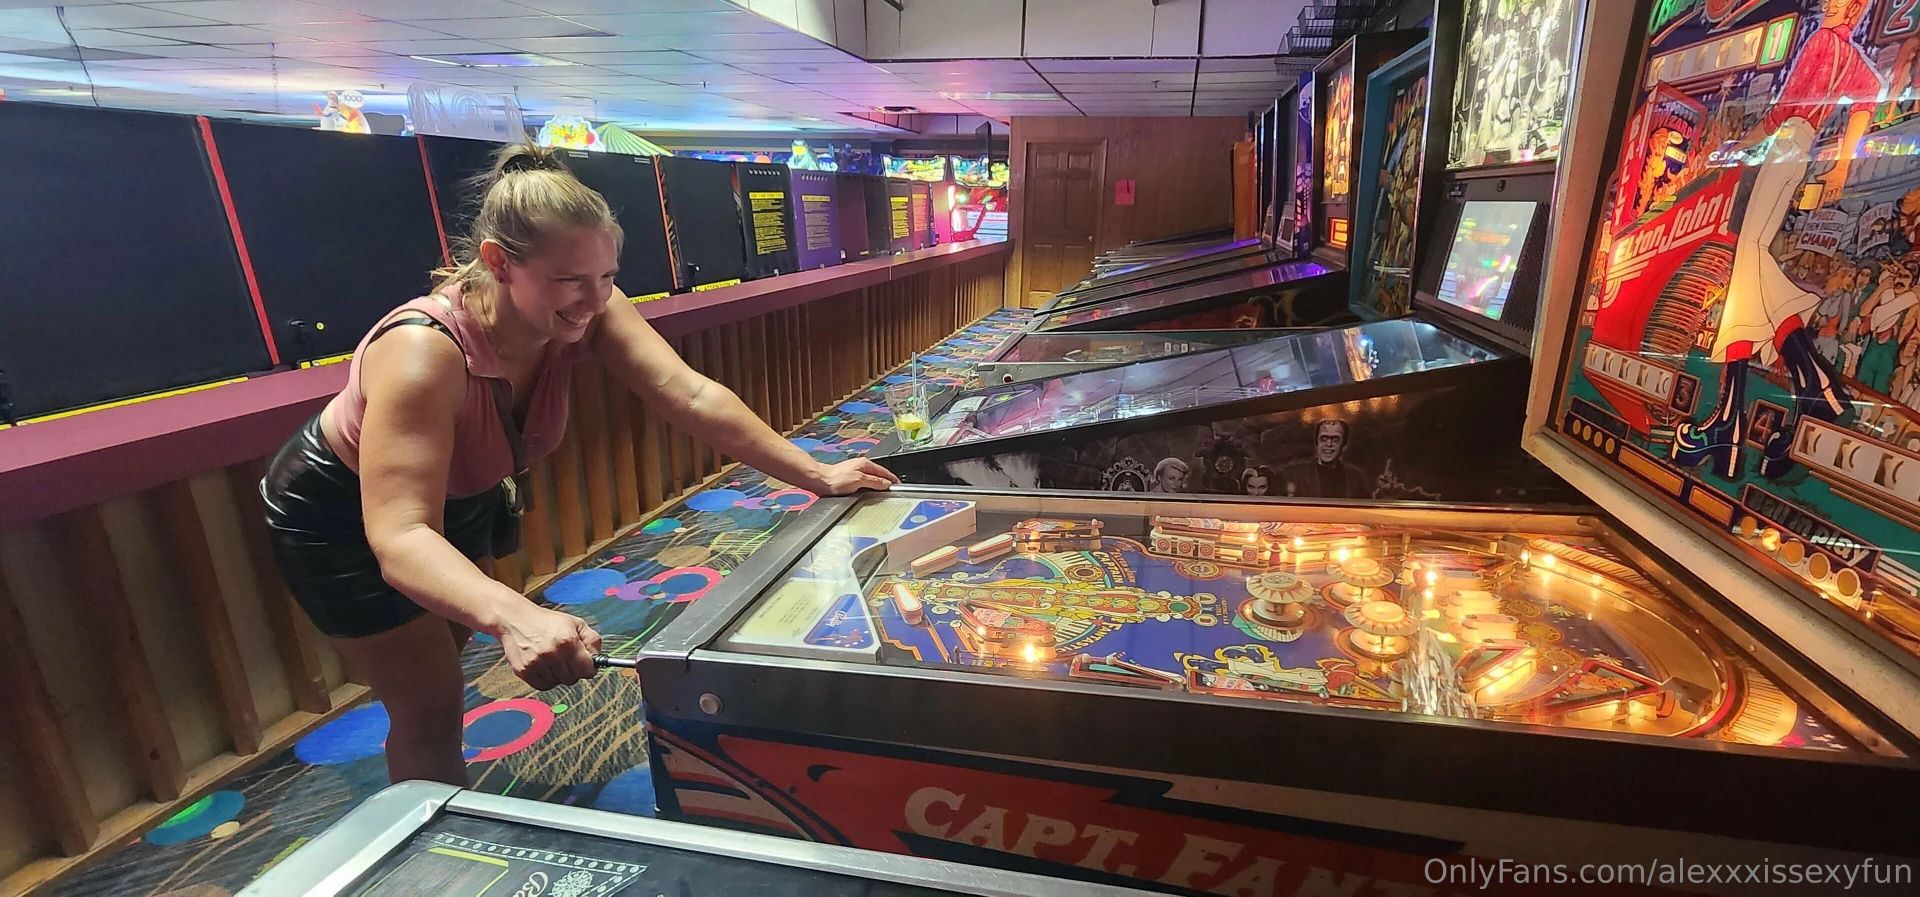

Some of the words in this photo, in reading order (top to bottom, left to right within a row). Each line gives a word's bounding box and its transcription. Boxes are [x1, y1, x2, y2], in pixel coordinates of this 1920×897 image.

[1883, 0, 1917, 35] 2
[1769, 21, 1785, 61] 1
[1614, 113, 1642, 227] BALLY
[1658, 193, 1724, 254] John
[1801, 232, 1838, 251] CHAMP
[1676, 380, 1693, 408] 3
[1755, 411, 1773, 440] 4
[1749, 493, 1791, 525] Ball
[1810, 525, 1871, 568] play
[1092, 551, 1125, 584] CAPTAIN
[1055, 622, 1124, 653] FANTASTIC
[904, 786, 1140, 877] CAPT.
